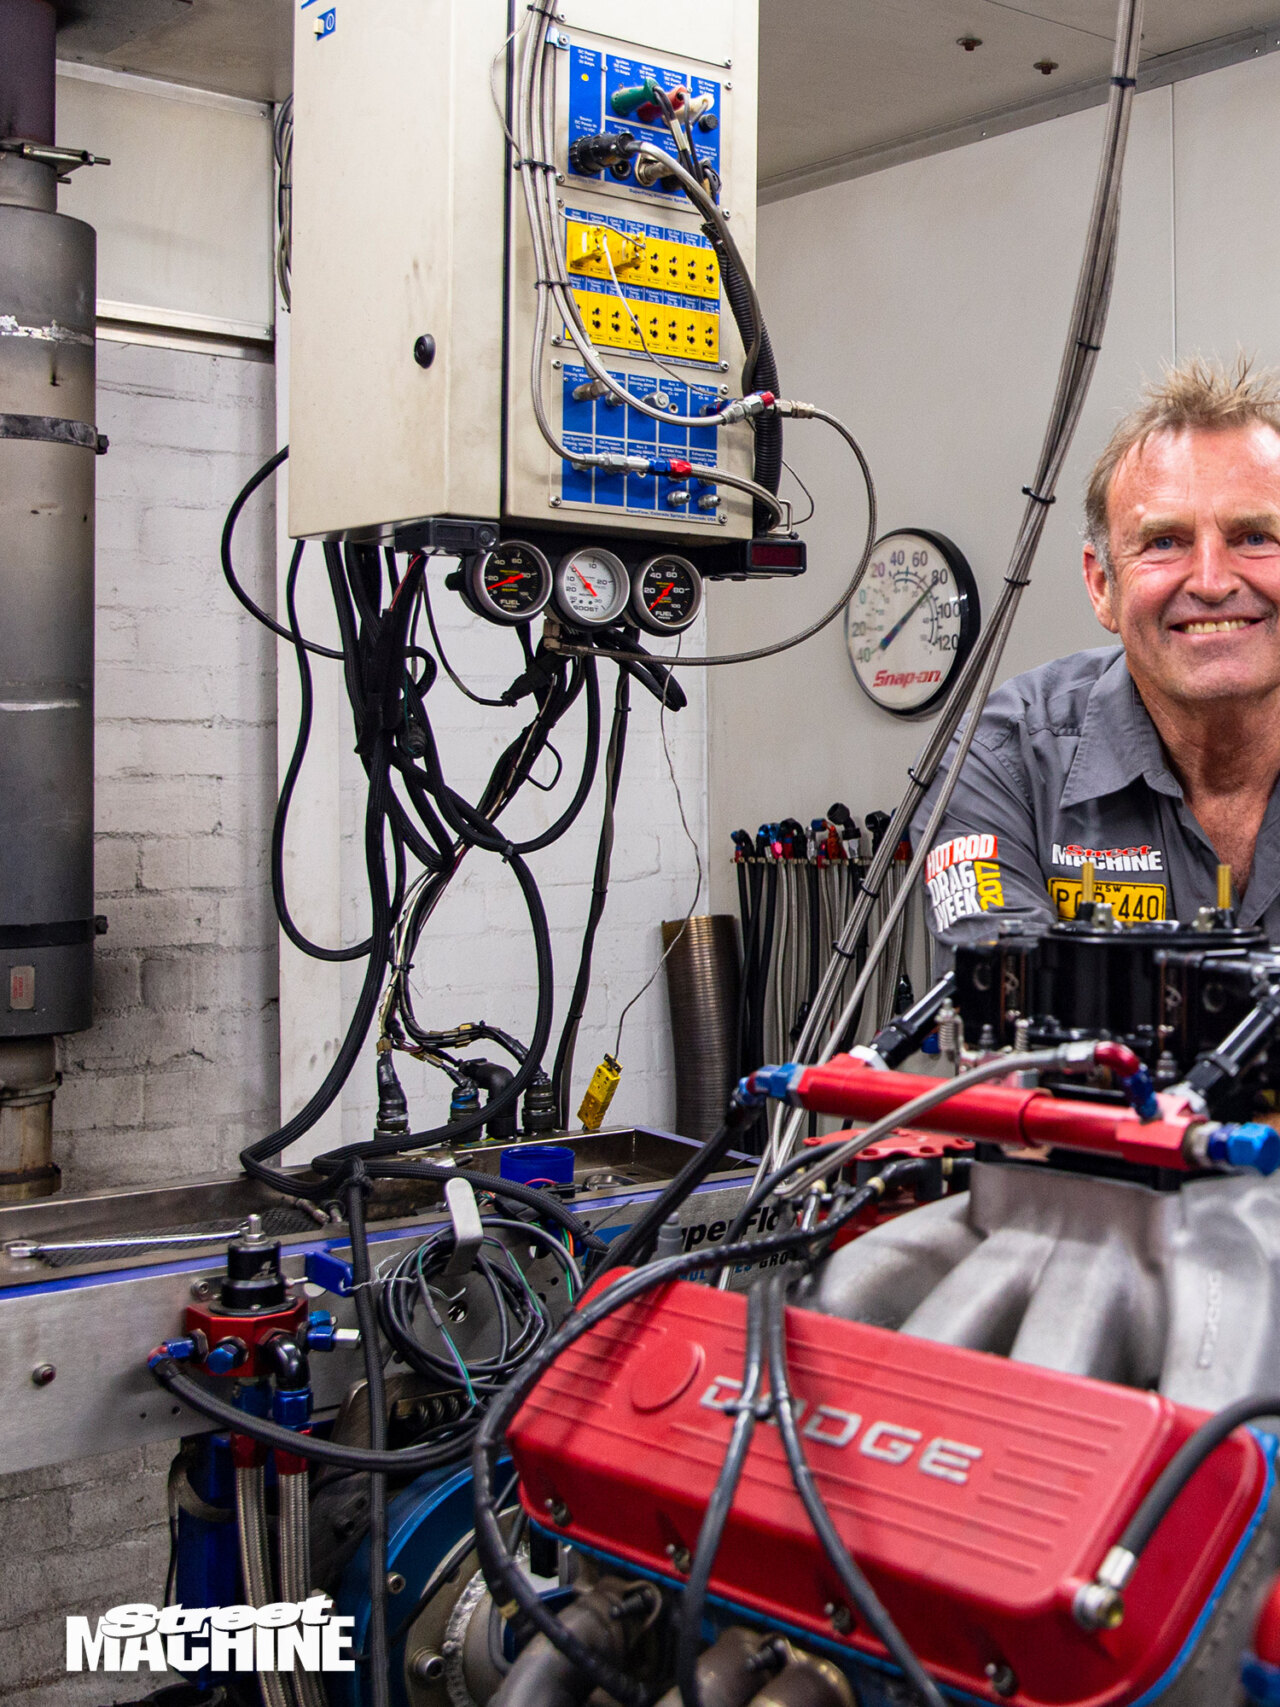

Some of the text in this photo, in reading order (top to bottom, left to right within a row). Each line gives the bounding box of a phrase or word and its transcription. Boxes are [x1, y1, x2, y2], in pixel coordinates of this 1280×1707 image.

[889, 550, 905, 566] 40
[912, 551, 928, 567] 60
[931, 568, 948, 585] 80
[940, 633, 960, 651] 120
[873, 670, 941, 688] Snap-on
[1065, 844, 1152, 858] Street
[928, 861, 977, 908] DRAG
[974, 861, 1005, 911] 2017
[934, 886, 982, 933] WEEK
[759, 1251, 788, 1269] GRO
[700, 1375, 983, 1484] DDGE
